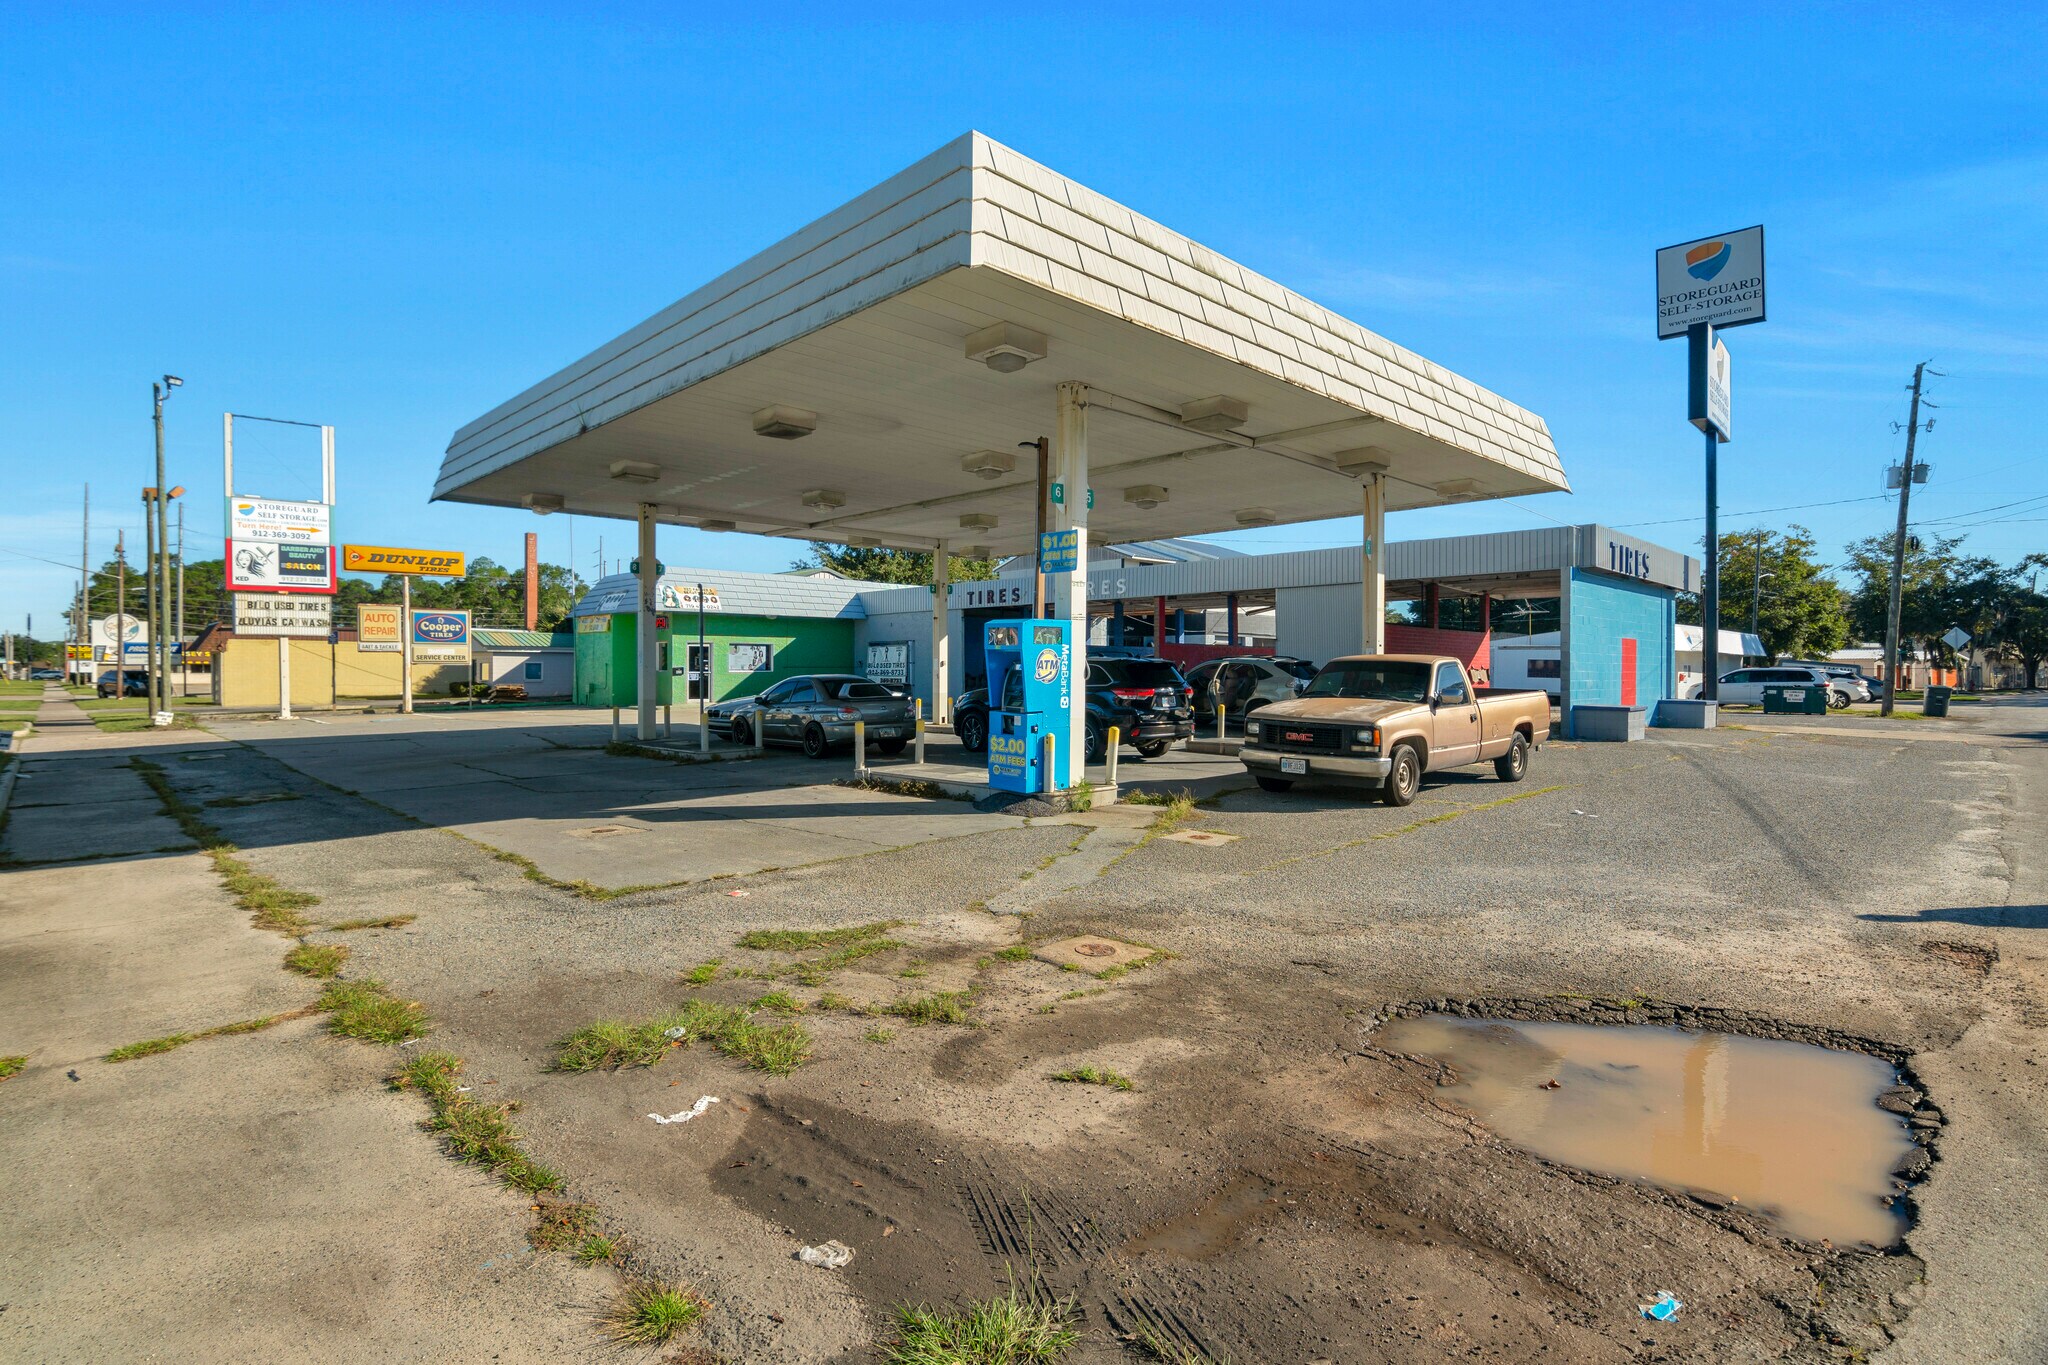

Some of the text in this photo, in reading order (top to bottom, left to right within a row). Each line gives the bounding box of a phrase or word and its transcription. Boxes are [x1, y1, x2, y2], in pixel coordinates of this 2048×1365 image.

[1659, 277, 1761, 307] STOREGUARD
[1659, 289, 1762, 318] SELF-STORAGE
[1668, 306, 1752, 327] www.storeguard.com
[1055, 486, 1062, 498] 6
[257, 503, 319, 514] STOREGUARD
[257, 511, 277, 519] SELF
[237, 521, 282, 531] Turn Here!
[252, 529, 311, 540] 912-369-3092
[1043, 533, 1077, 550] $1.00
[289, 552, 317, 560] BEAUTY
[367, 553, 461, 567] DUNLOP
[1043, 550, 1061, 561] ATM
[1609, 541, 1650, 579] TIRES
[285, 562, 321, 570] SALON
[632, 563, 637, 571] 8
[1086, 578, 1128, 597] RES
[967, 587, 1020, 606] TIRES
[298, 602, 327, 612] TIRES
[364, 613, 397, 624] AUTO
[364, 626, 397, 637] REPAIR
[420, 621, 462, 633] Cooper
[1037, 659, 1059, 670] ATM
[1060, 643, 1070, 695] MetaBank
[1285, 731, 1314, 741] GMC
[990, 734, 1026, 754] $2.00
[990, 753, 1026, 767] ATM FEES
